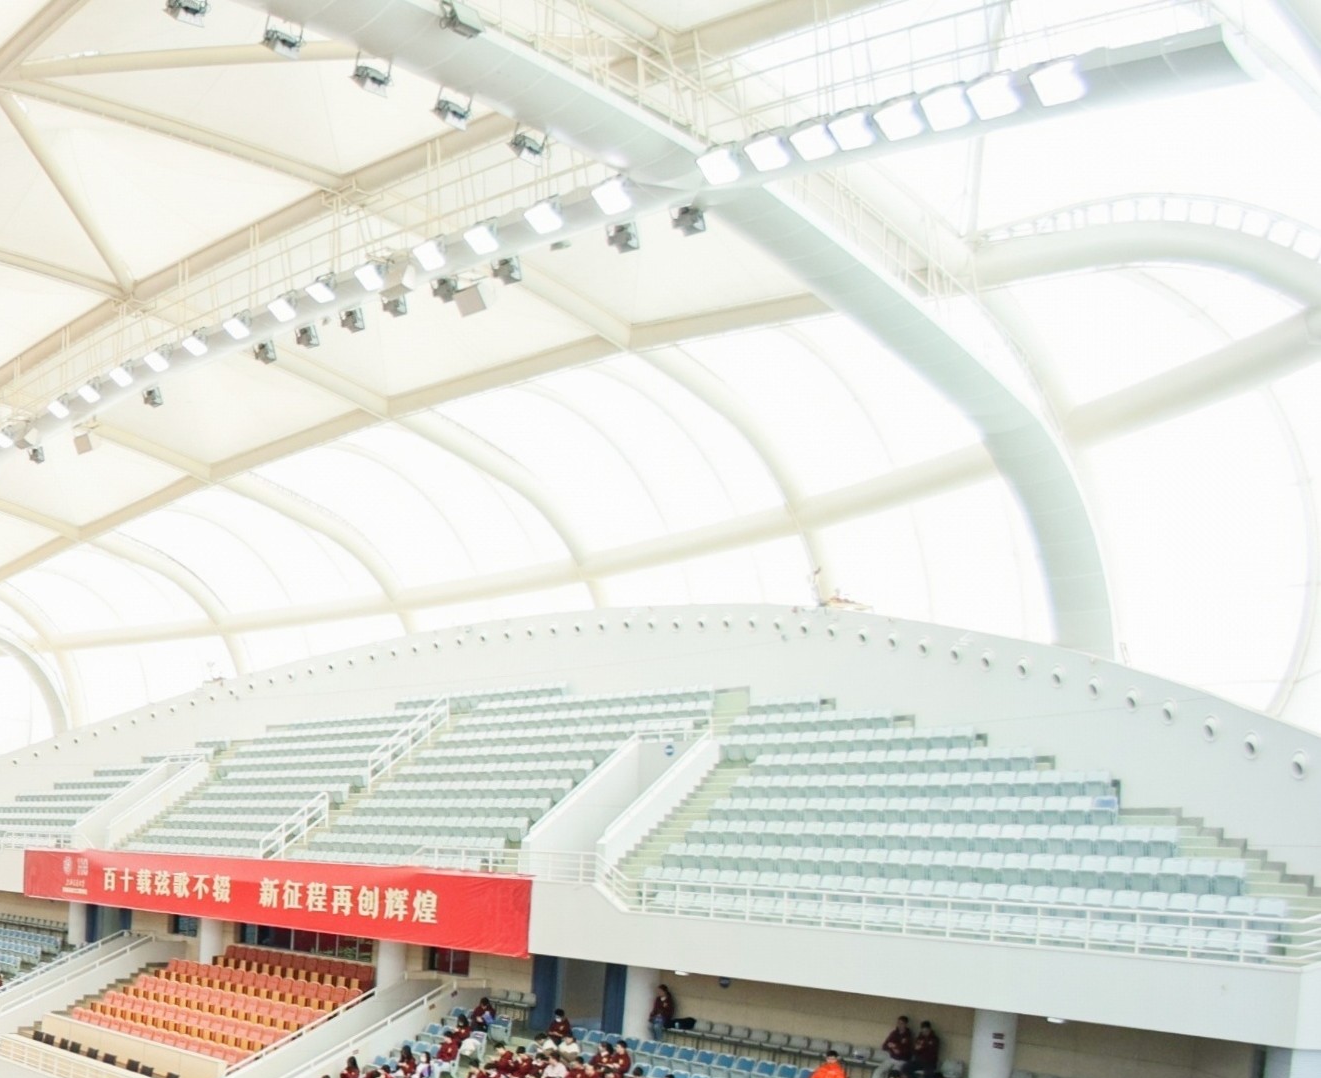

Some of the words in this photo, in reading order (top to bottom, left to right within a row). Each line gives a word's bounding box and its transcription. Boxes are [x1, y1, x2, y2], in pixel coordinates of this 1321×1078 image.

[102, 867, 231, 904] 百十载弦歌不辍
[258, 876, 439, 924] 新征程再创辉煌
